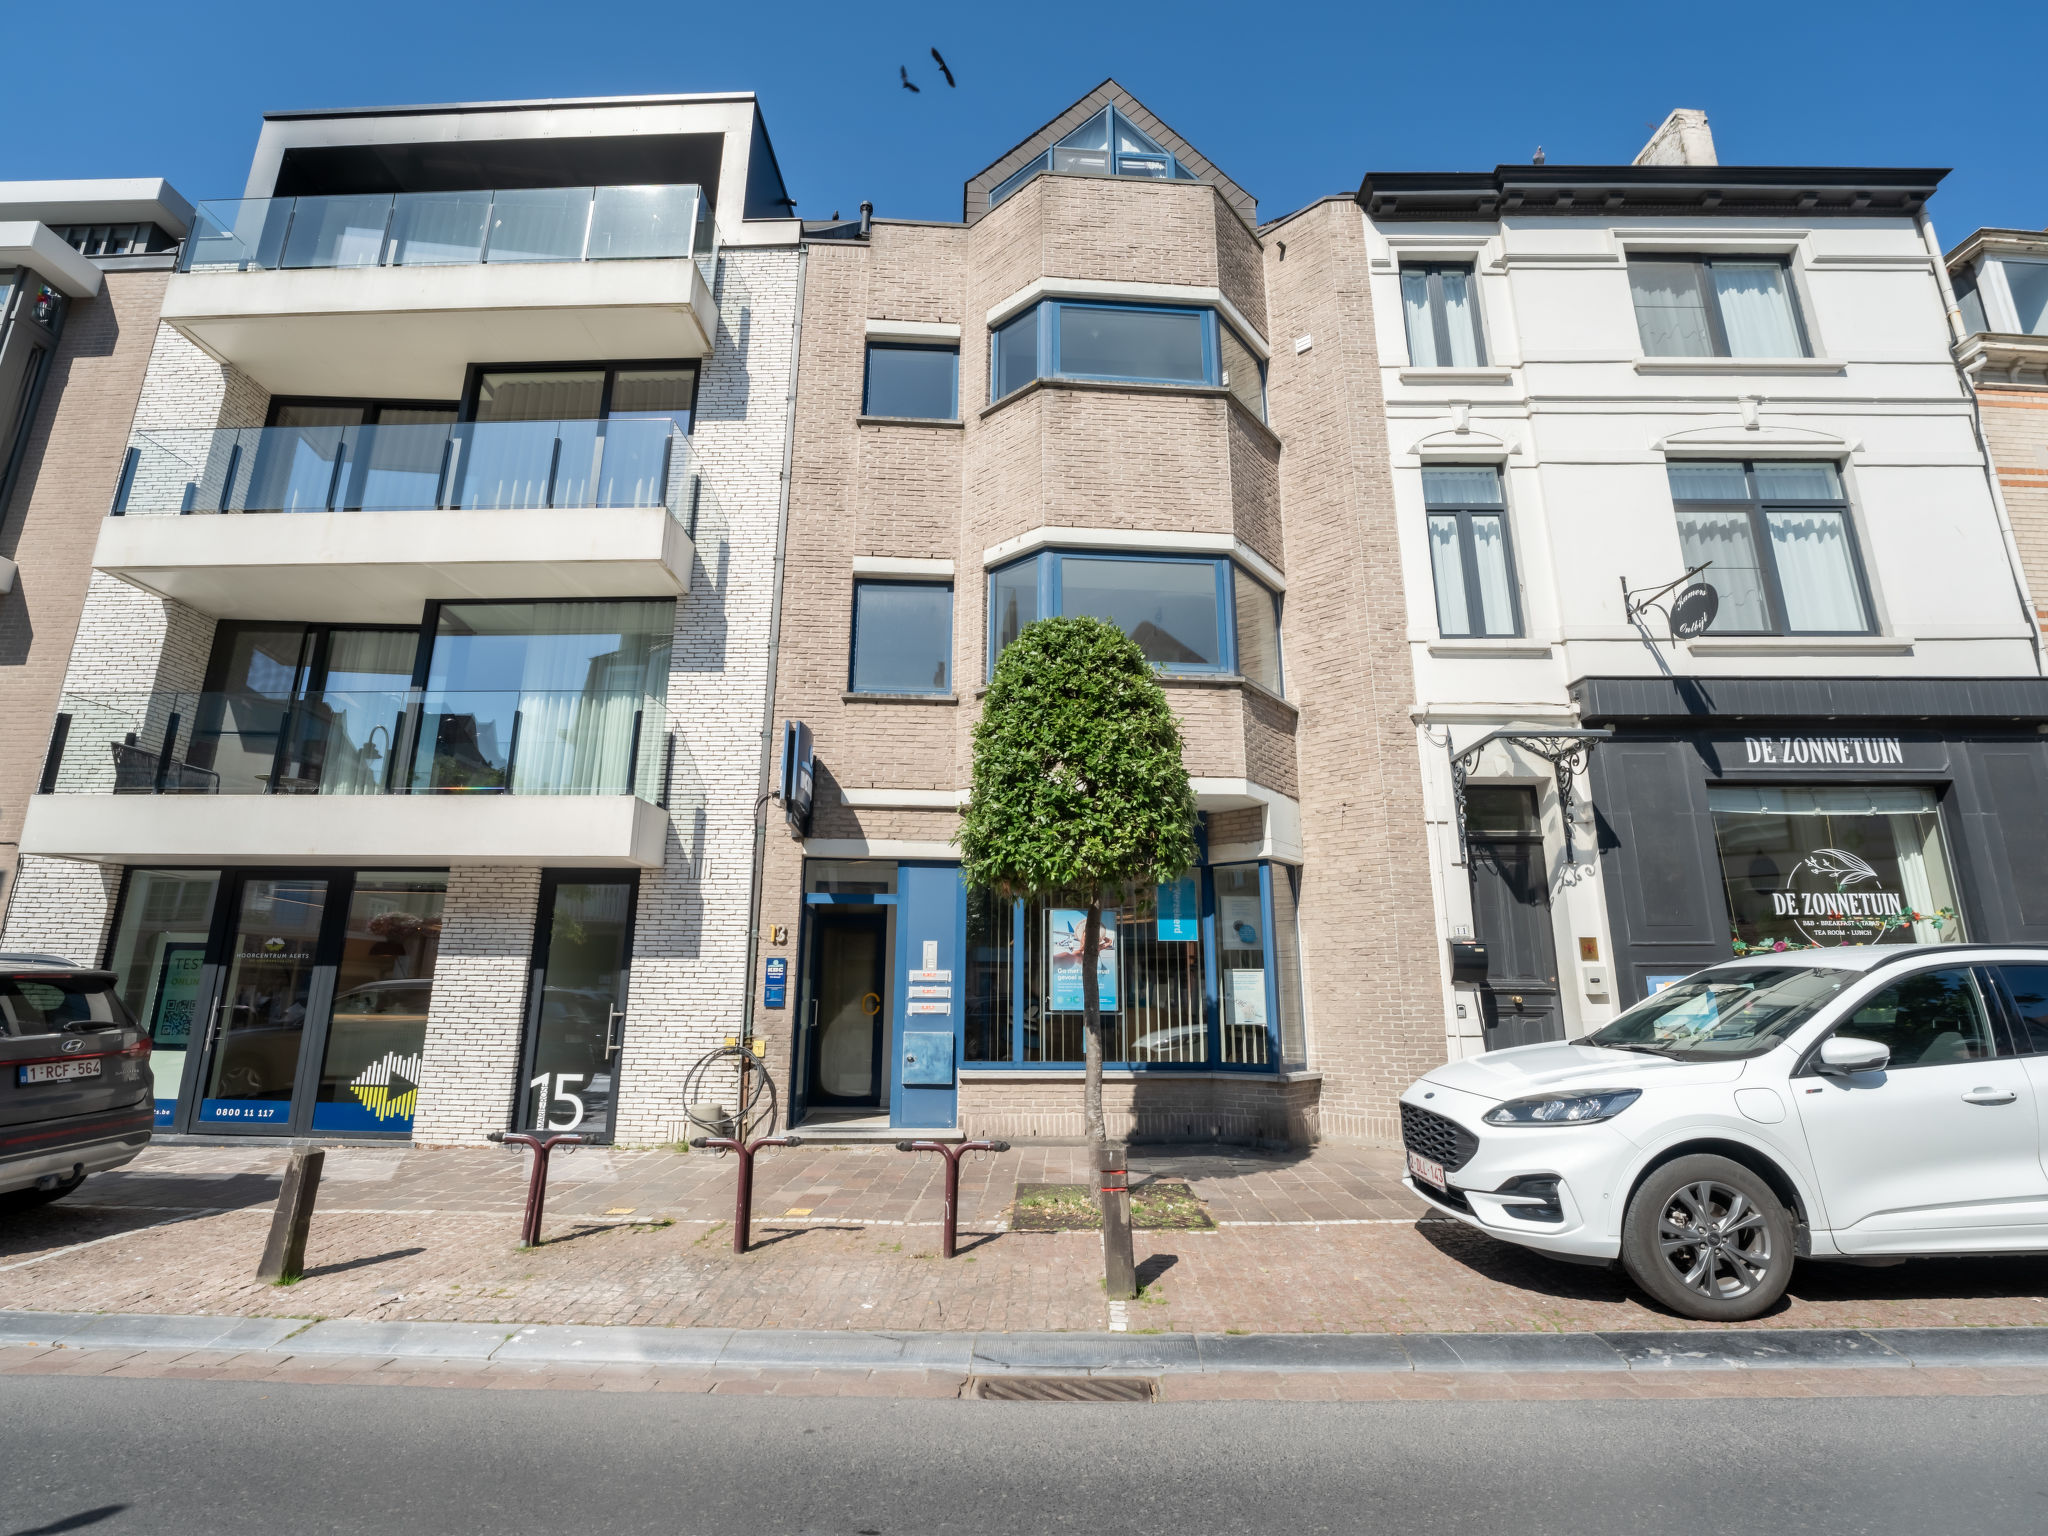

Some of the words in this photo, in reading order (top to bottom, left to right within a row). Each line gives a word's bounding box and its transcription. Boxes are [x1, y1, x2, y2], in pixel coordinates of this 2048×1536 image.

[1744, 737, 1777, 764] DE
[1779, 737, 1904, 764] ZONNETUIN
[1772, 893, 1799, 915] DE
[1801, 893, 1902, 916] ZONNETUIN
[769, 923, 786, 942] 13
[171, 977, 199, 986] ONLIN
[530, 1072, 584, 1132] 15
[216, 1108, 241, 1117] 0800
[243, 1108, 255, 1117] 11
[257, 1108, 275, 1118] 117
